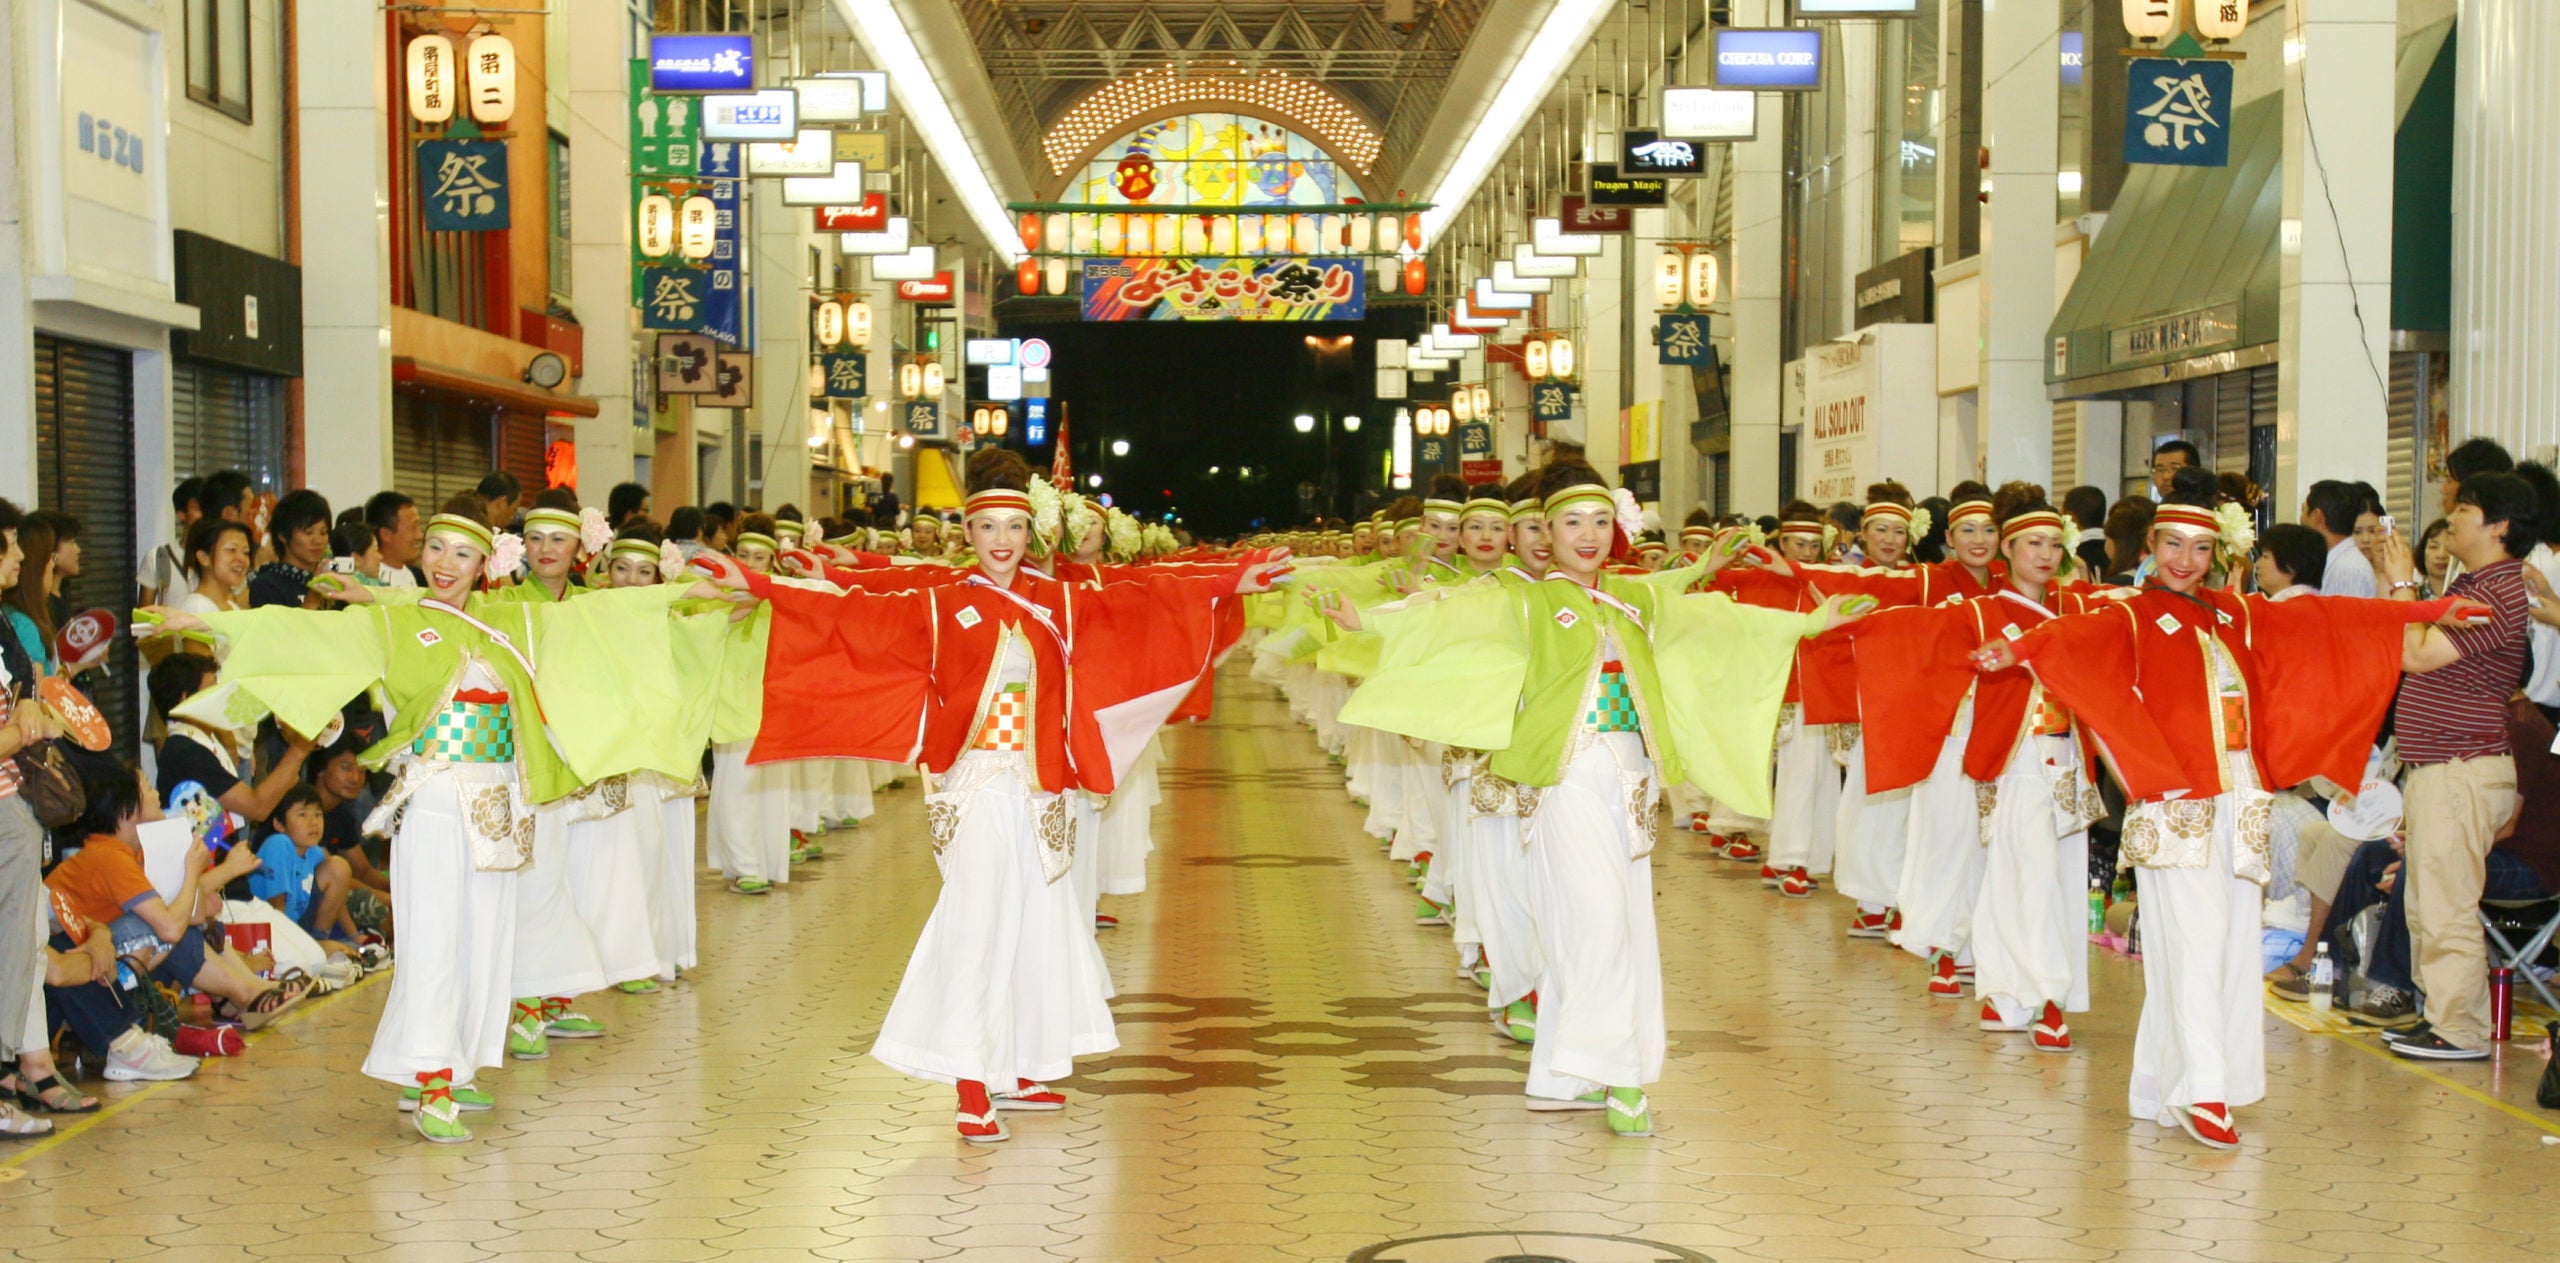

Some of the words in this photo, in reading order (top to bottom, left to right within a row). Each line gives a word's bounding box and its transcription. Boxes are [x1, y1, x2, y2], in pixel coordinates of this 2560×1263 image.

[1718, 52, 1775, 66] CHIGUSA
[1777, 52, 1815, 66] CORP.
[480, 52, 502, 105] 第二
[432, 151, 502, 217] 祭
[1594, 180, 1629, 193] Dragon
[1633, 180, 1663, 193] Magic
[1087, 265, 1132, 278] 第58回
[1120, 262, 1354, 303] よさこい祭り
[650, 275, 700, 321] 祭
[1227, 308, 1274, 316] FESTIVAL
[829, 358, 863, 391] 祭
[910, 405, 936, 431] 祭
[1028, 405, 1046, 440] 銀行
[1814, 404, 1827, 440] ALL
[1829, 398, 1848, 438] SOLD
[1850, 395, 1865, 434] OUT
